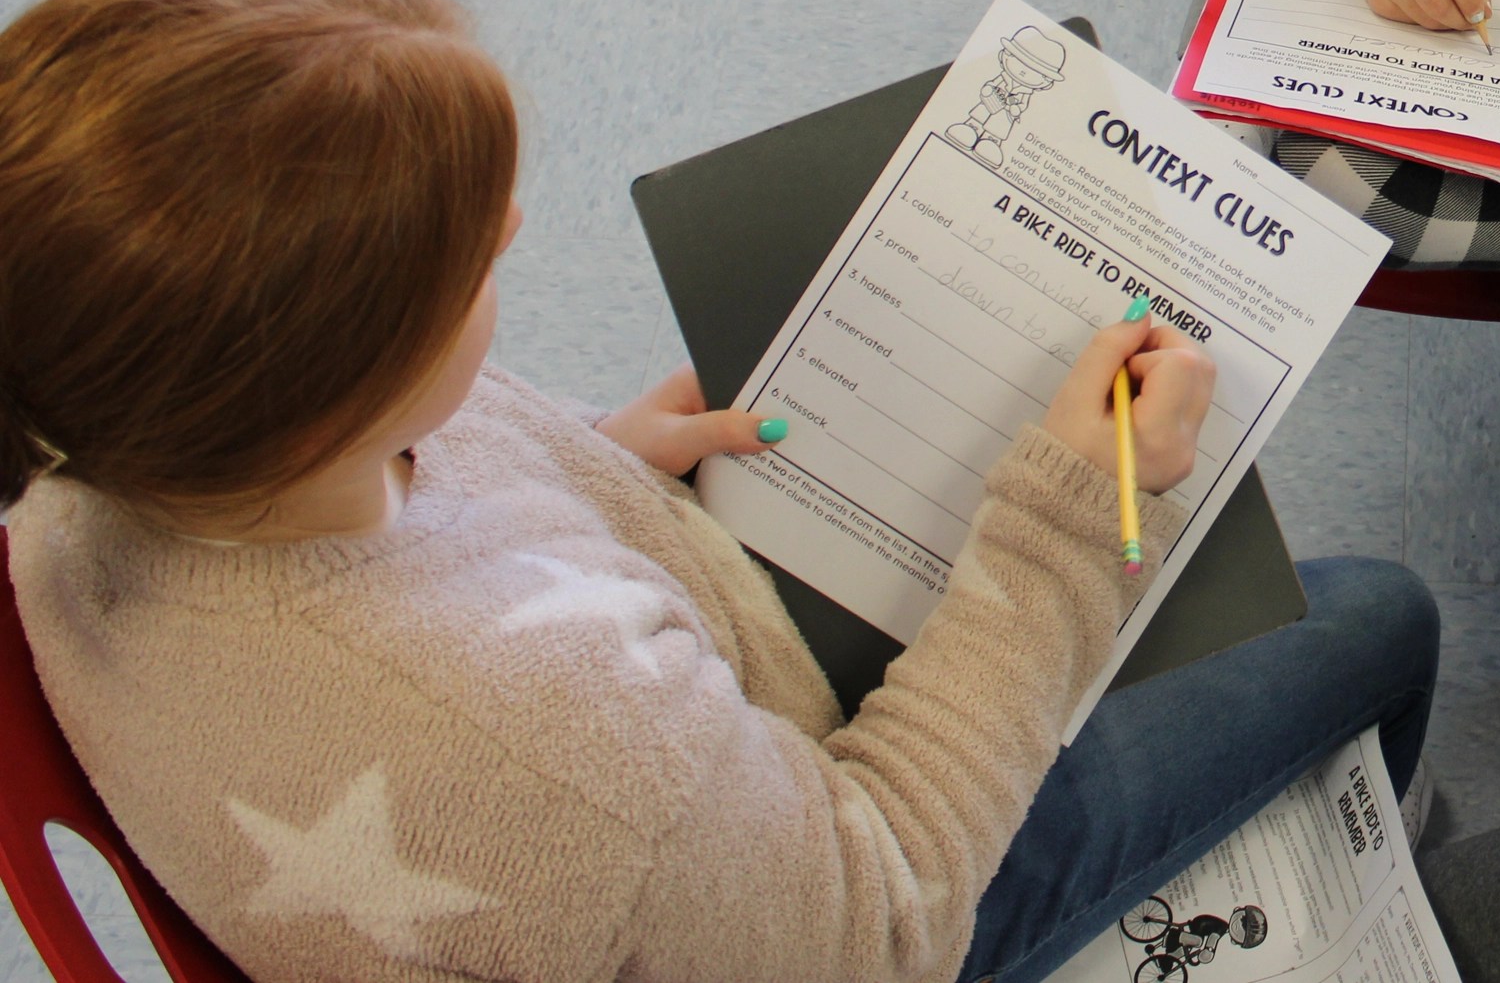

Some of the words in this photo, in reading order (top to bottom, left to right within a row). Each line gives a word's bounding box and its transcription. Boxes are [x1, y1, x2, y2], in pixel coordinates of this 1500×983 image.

[1297, 39, 1380, 60] REMEMBER
[1384, 55, 1405, 65] TO
[1410, 60, 1444, 73] RIDE
[1272, 75, 1343, 98] CLUES
[1449, 67, 1484, 81] BIKE
[1489, 76, 1500, 85] A
[1321, 104, 1346, 112] Name
[1353, 91, 1468, 120] CONTEXT
[1087, 109, 1213, 202] CONTEXT
[1214, 192, 1294, 256] CLUES
[1232, 158, 1258, 179] Name
[900, 190, 908, 202] 1.
[911, 198, 953, 228] cajoled
[1002, 166, 1046, 202] following
[1047, 197, 1071, 216] each
[1072, 213, 1099, 235] word.
[873, 229, 884, 241] 2.
[884, 238, 918, 263] prone
[966, 224, 994, 252] to
[993, 194, 1010, 213] A
[1011, 204, 1055, 241] BIKE
[1053, 231, 1096, 267] RIDE
[1096, 258, 1120, 282] TO
[1010, 156, 1036, 177] word.
[1038, 173, 1066, 198] Using
[1065, 193, 1090, 210] your
[1090, 209, 1111, 226] own
[1112, 222, 1142, 249] words,
[1145, 244, 1170, 264] write
[1171, 261, 1179, 270] a
[1179, 267, 1226, 300] definition
[1226, 297, 1239, 309] on
[1240, 305, 1257, 321] the
[1257, 316, 1275, 333] line
[1016, 142, 1041, 164] bold.
[1042, 159, 1061, 177] Use
[1062, 174, 1100, 201] context
[1099, 199, 1125, 218] clues
[1125, 214, 1137, 226] to
[1137, 223, 1187, 259] determine
[1187, 255, 1204, 270] the
[1204, 267, 1248, 300] meaning
[1248, 296, 1261, 306] of
[1260, 304, 1284, 322] each
[1024, 131, 1076, 170] Directions:
[1076, 165, 1104, 187] Read
[1103, 185, 1128, 204] each
[1126, 201, 1166, 227] partner
[1163, 225, 1188, 244] play
[1187, 240, 1216, 263] script.
[1218, 258, 1244, 279] Look
[1243, 276, 1256, 287] at
[1256, 283, 1273, 298] the
[1274, 295, 1303, 319] words
[1303, 313, 1314, 326] in
[847, 268, 858, 280] 3.
[859, 275, 901, 308] hapless
[823, 309, 832, 321] 4.
[834, 318, 892, 357] enervated
[796, 347, 806, 360] 5.
[808, 357, 858, 391] elevated
[770, 387, 779, 399] 6.
[782, 393, 827, 428] hassock
[747, 464, 785, 491] context
[785, 489, 811, 509] clues
[824, 513, 874, 549] determine
[875, 545, 892, 560] the
[892, 557, 936, 590] meaning
[767, 459, 787, 476] two
[800, 480, 817, 495] the
[818, 492, 847, 515] words
[848, 511, 873, 531] from
[873, 528, 890, 543] the
[890, 538, 907, 555] list.
[923, 559, 940, 575] the
[1336, 790, 1367, 857] REMEMBER
[1352, 775, 1371, 808] BIKE
[1362, 802, 1380, 836] RIDE
